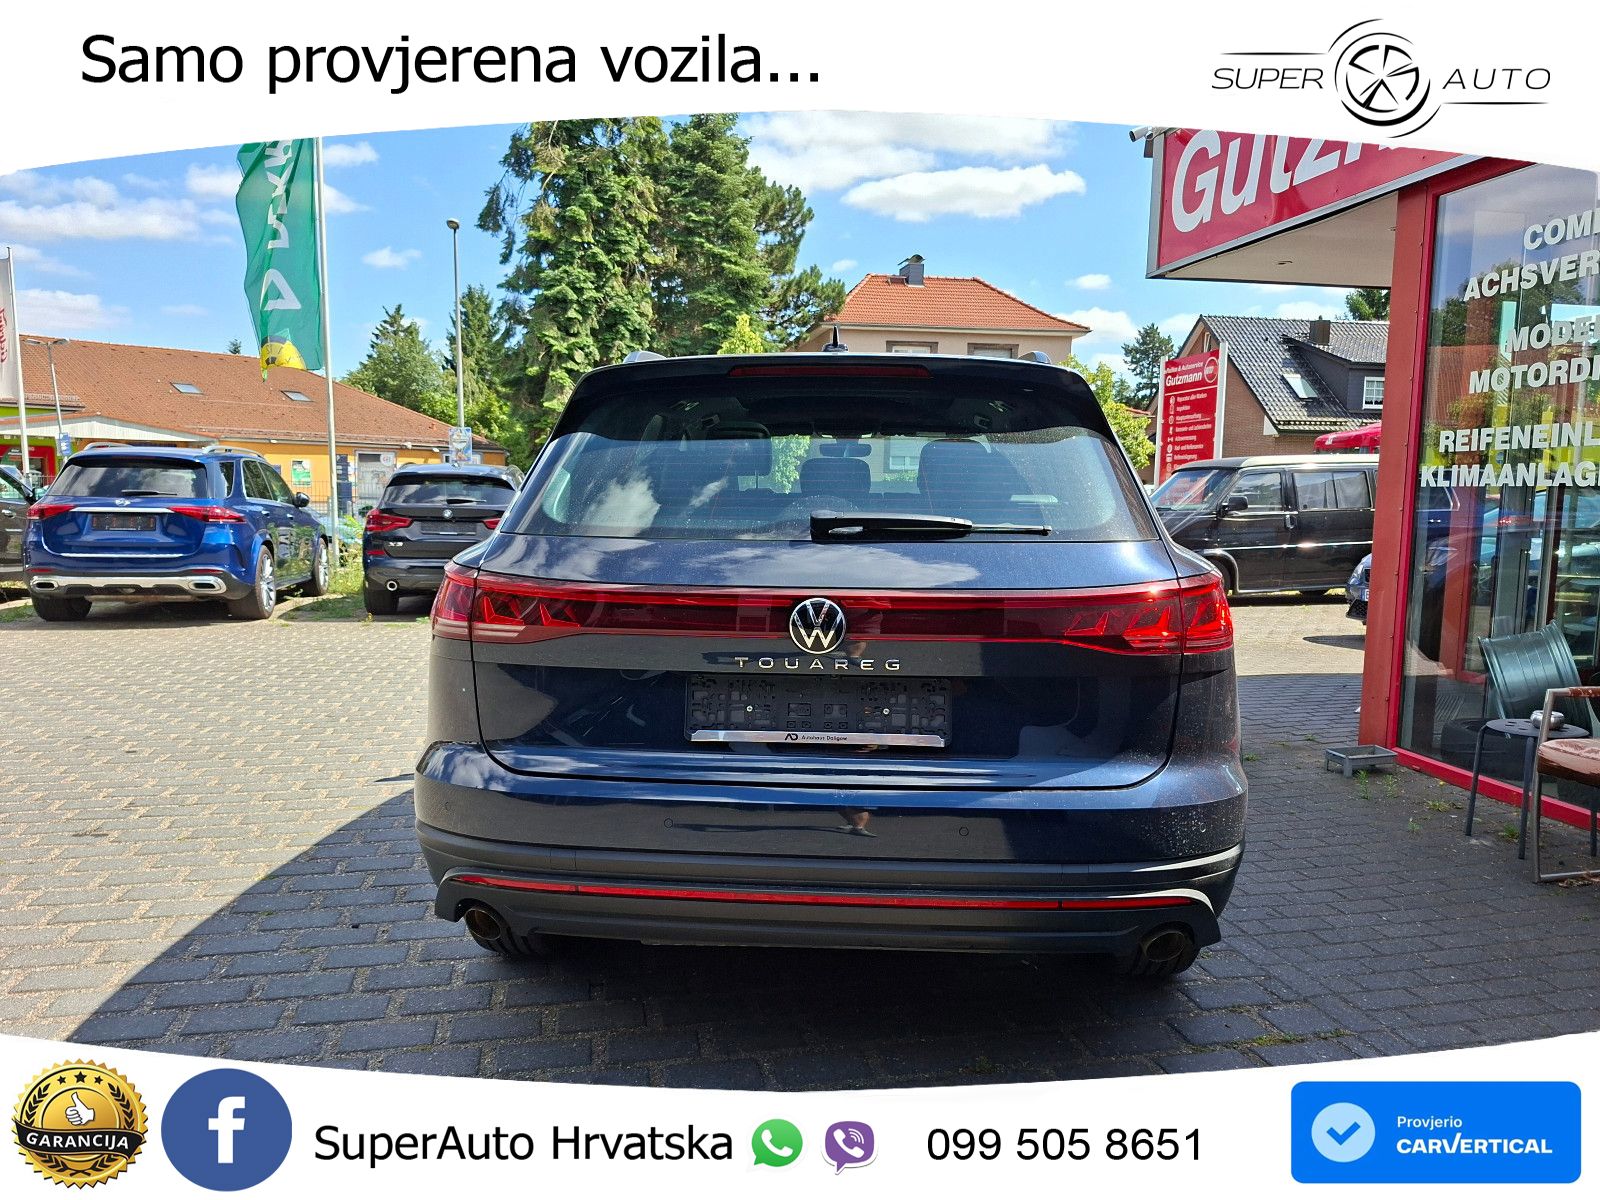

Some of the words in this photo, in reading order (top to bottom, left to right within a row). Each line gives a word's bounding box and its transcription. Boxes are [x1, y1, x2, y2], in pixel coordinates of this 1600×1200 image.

[1172, 130, 1391, 233] Gutz
[1463, 250, 1600, 301] ACHSVER
[1166, 371, 1203, 387] Gutzmann
[1420, 460, 1600, 488] KLIMAANLAG
[734, 656, 901, 671] TOUAREG
